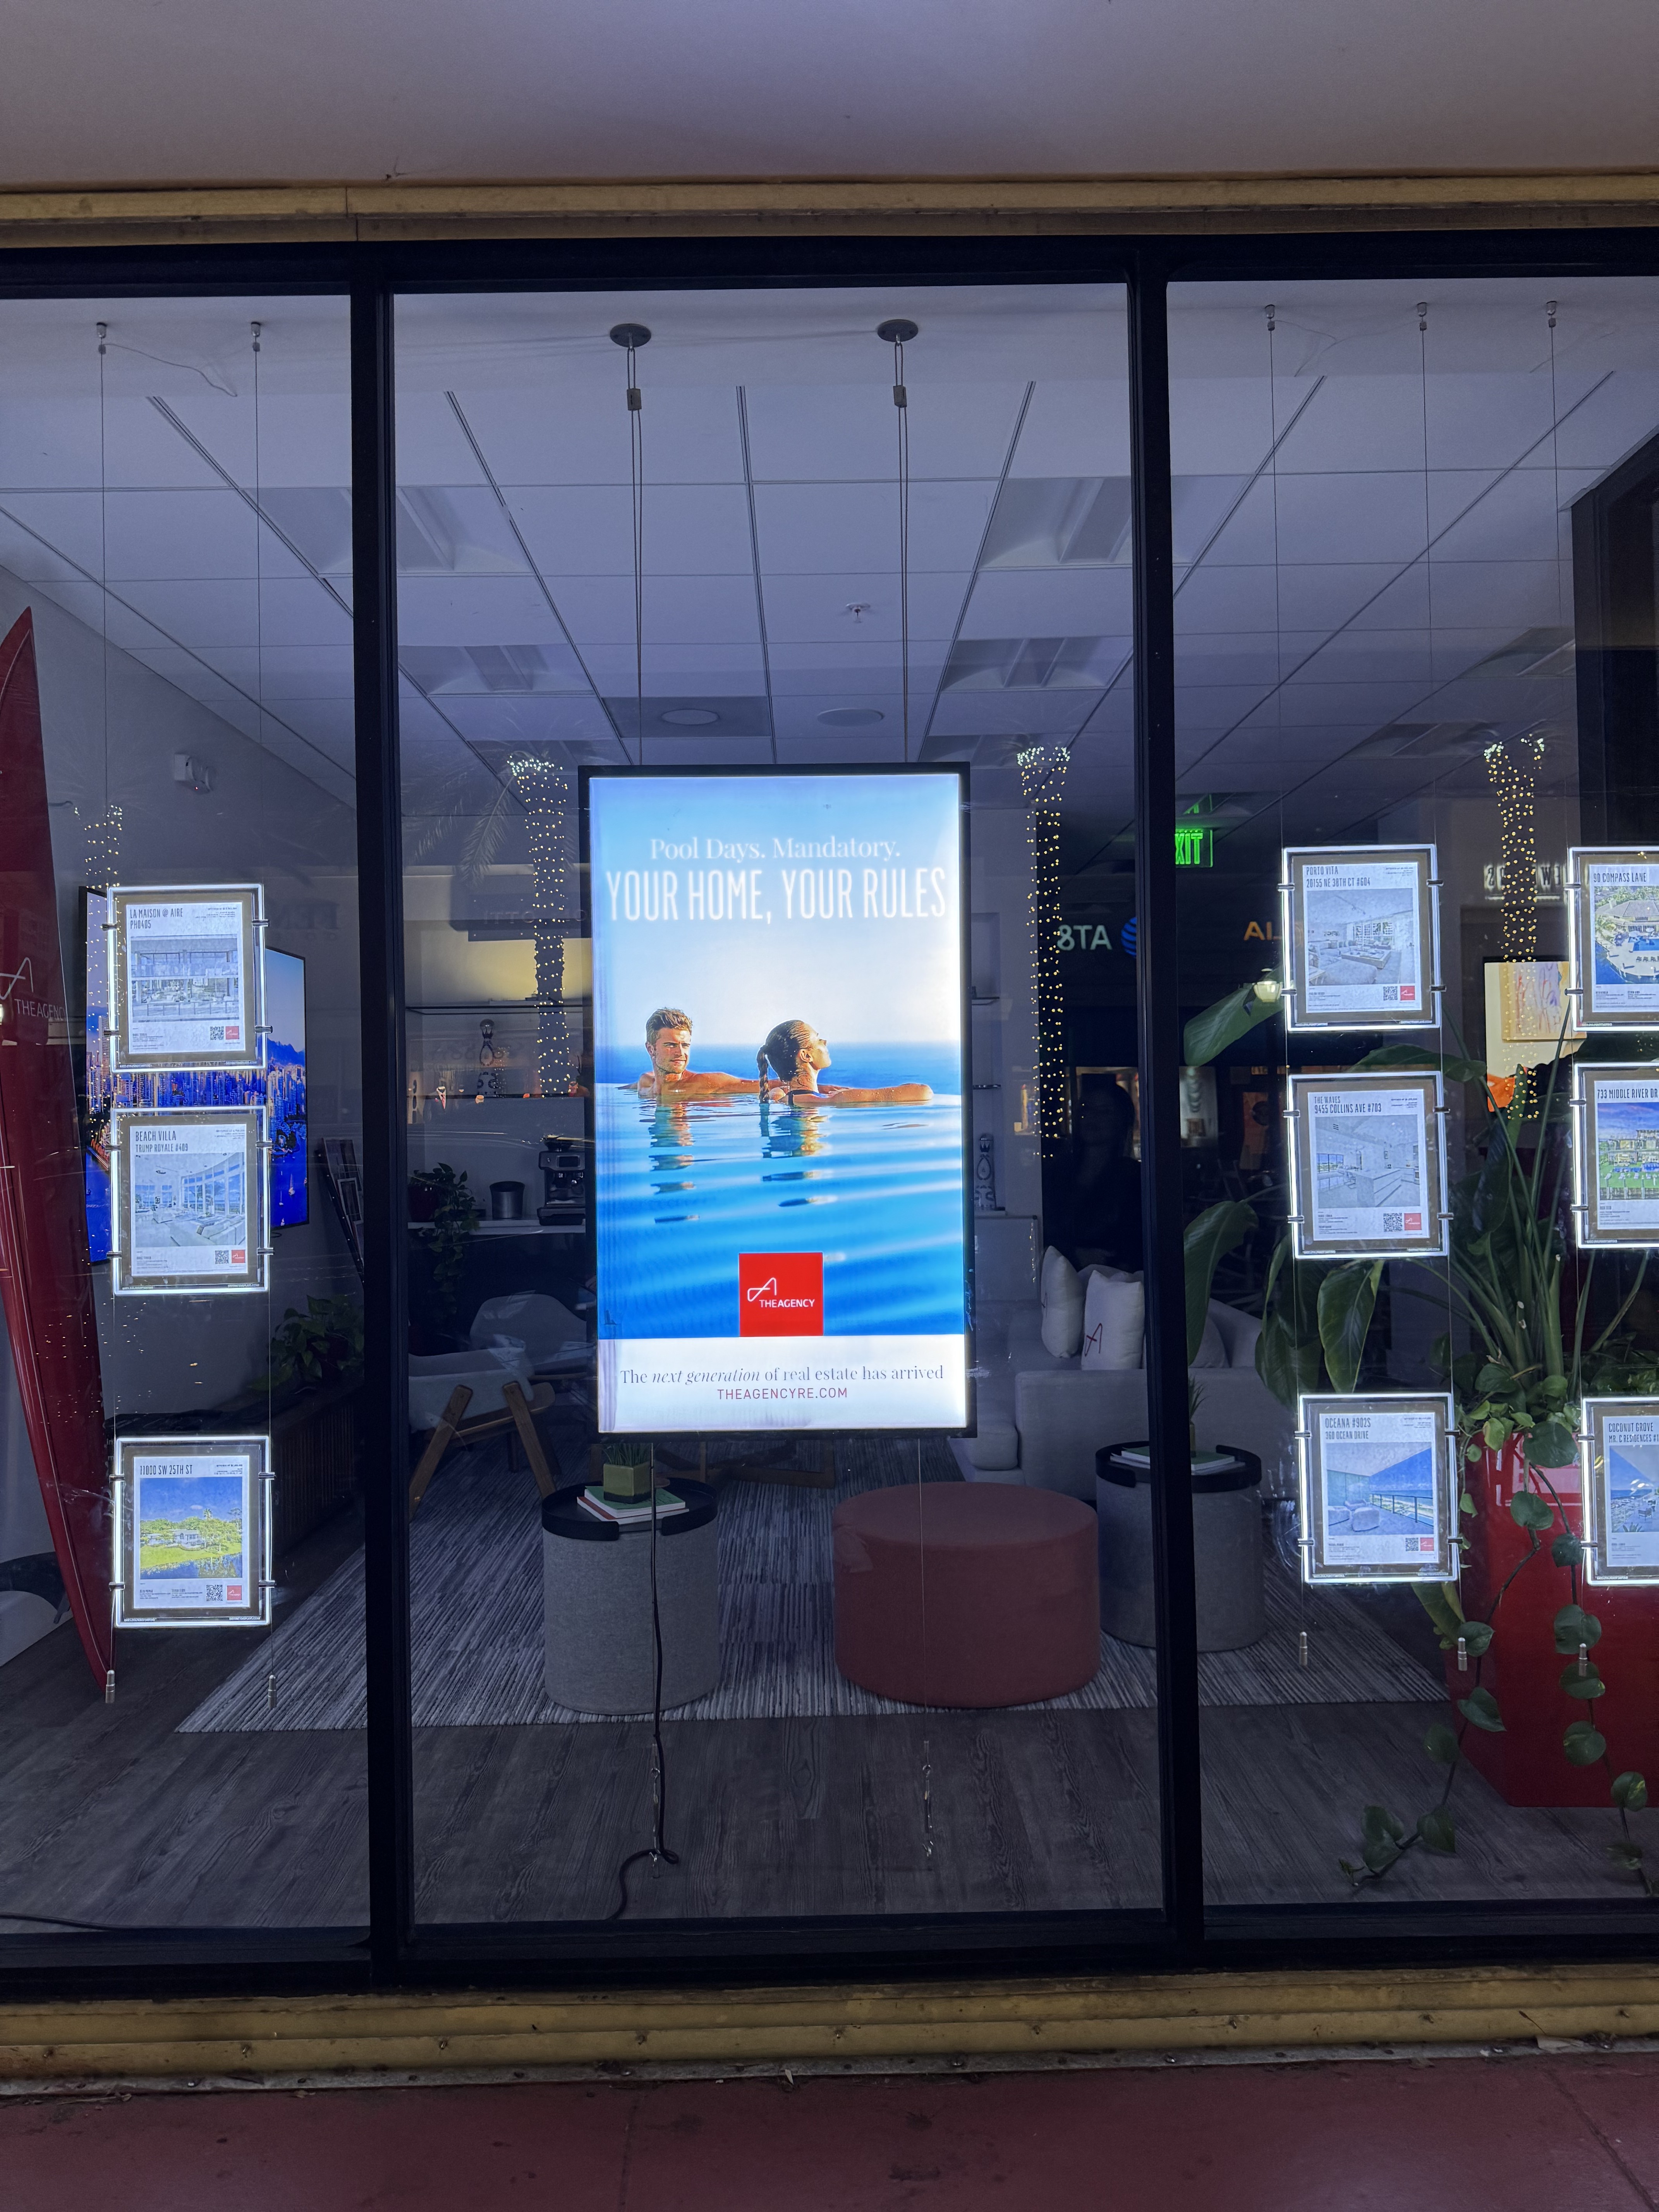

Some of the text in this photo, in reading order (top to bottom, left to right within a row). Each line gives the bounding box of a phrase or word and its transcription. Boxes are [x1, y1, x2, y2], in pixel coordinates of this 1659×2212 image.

[650, 836, 901, 863] Pool Days. Mandatory.
[1175, 833, 1203, 865] XIT
[1306, 866, 1338, 875] PORTO VITA
[1307, 878, 1322, 888] 20155
[1324, 878, 1331, 887] NE
[1348, 878, 1355, 887] CT
[1357, 877, 1370, 886] #604
[1602, 872, 1630, 883] COMPASS
[1632, 872, 1647, 882] LANE
[606, 867, 946, 924] YOUR HOME, YOUR RULES
[130, 908, 183, 919] LA MAISON @ AIRE
[14, 999, 66, 1021] THEAGENC
[1597, 1088, 1658, 1099] 733 MIDDLE RIVER DR
[1315, 1103, 1382, 1114] 9455 COLLINS AVE #703
[136, 1130, 176, 1141] BEACH VILLA
[136, 1143, 188, 1152] TRUMP ROYALE #409
[759, 1298, 815, 1309] THEAGENCY
[620, 1365, 943, 1385] The next generation of real estate has arrived
[717, 1388, 848, 1400] THEAGENCYRE.COM
[1325, 1417, 1371, 1428] OCEANA #902S
[1609, 1422, 1653, 1432] COCONUT GROVE
[1336, 1431, 1353, 1439] OCEAN
[1354, 1431, 1369, 1439] DRIVE
[1609, 1435, 1618, 1443] MR.
[1619, 1434, 1622, 1443] C
[1624, 1434, 1652, 1443] RESIDENCES
[141, 1464, 193, 1475] 11000 SW 25TH ST
